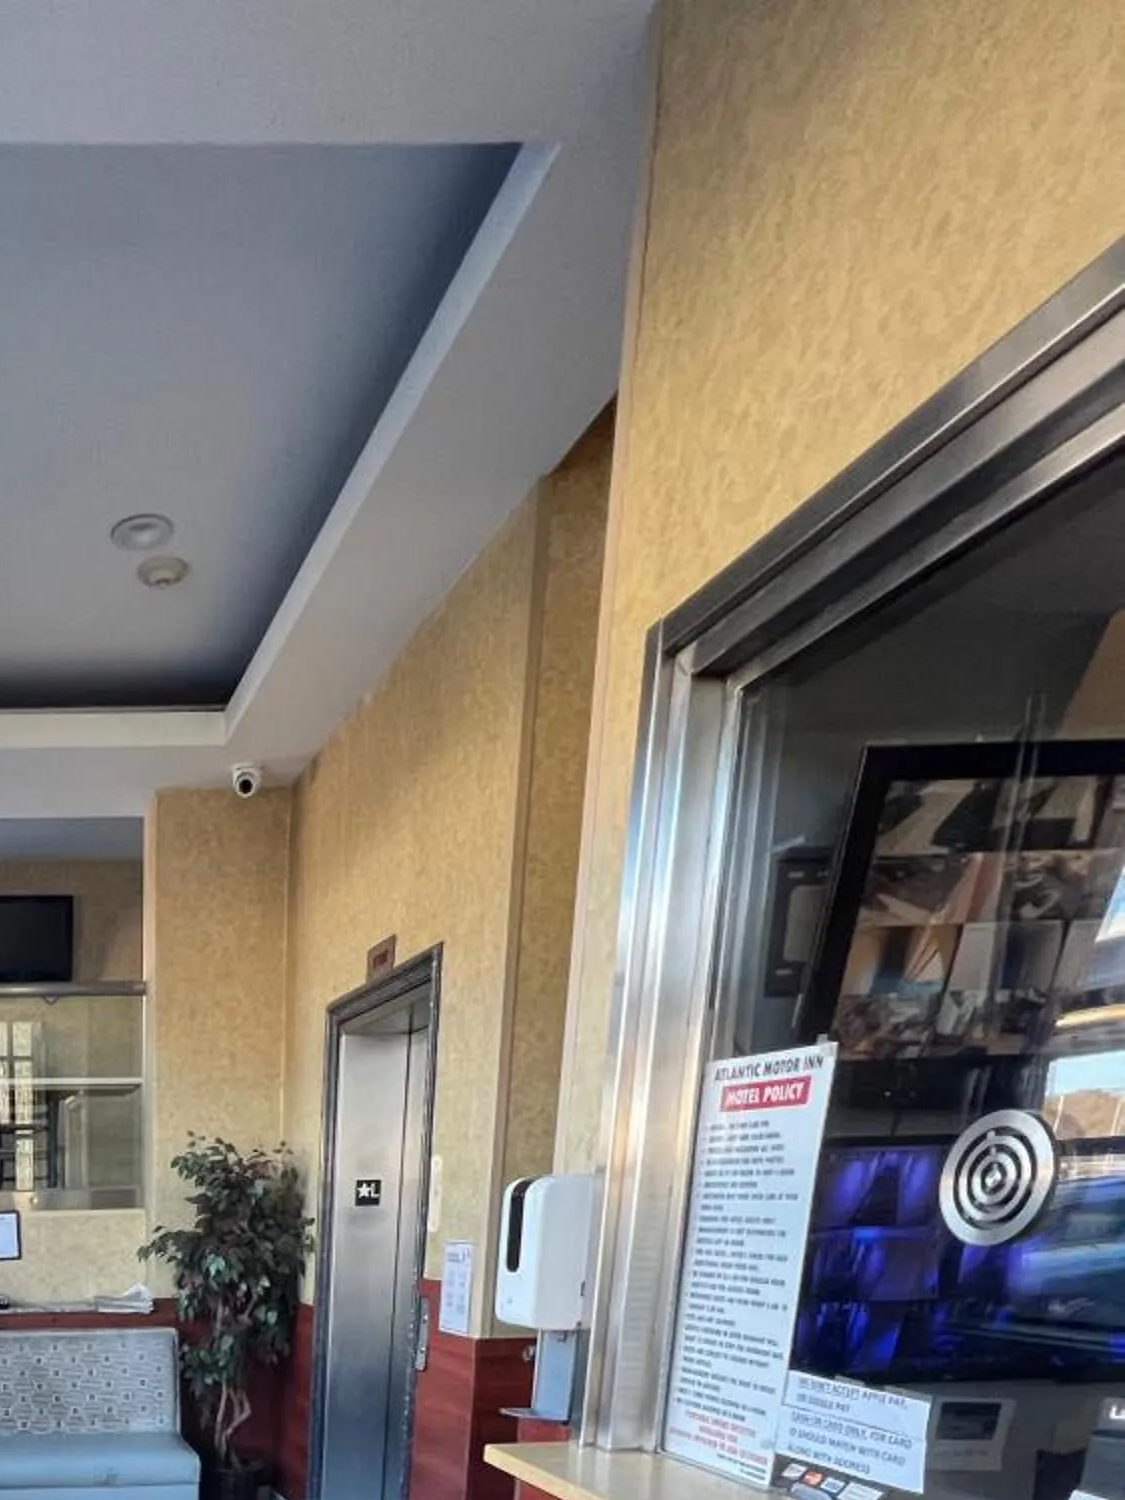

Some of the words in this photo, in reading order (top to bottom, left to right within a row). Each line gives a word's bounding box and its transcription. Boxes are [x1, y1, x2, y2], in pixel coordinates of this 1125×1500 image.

[715, 1063, 760, 1081] ATLANTIC
[763, 1057, 800, 1075] MOTOR
[803, 1055, 824, 1069] INN
[762, 1082, 804, 1103] POLICY
